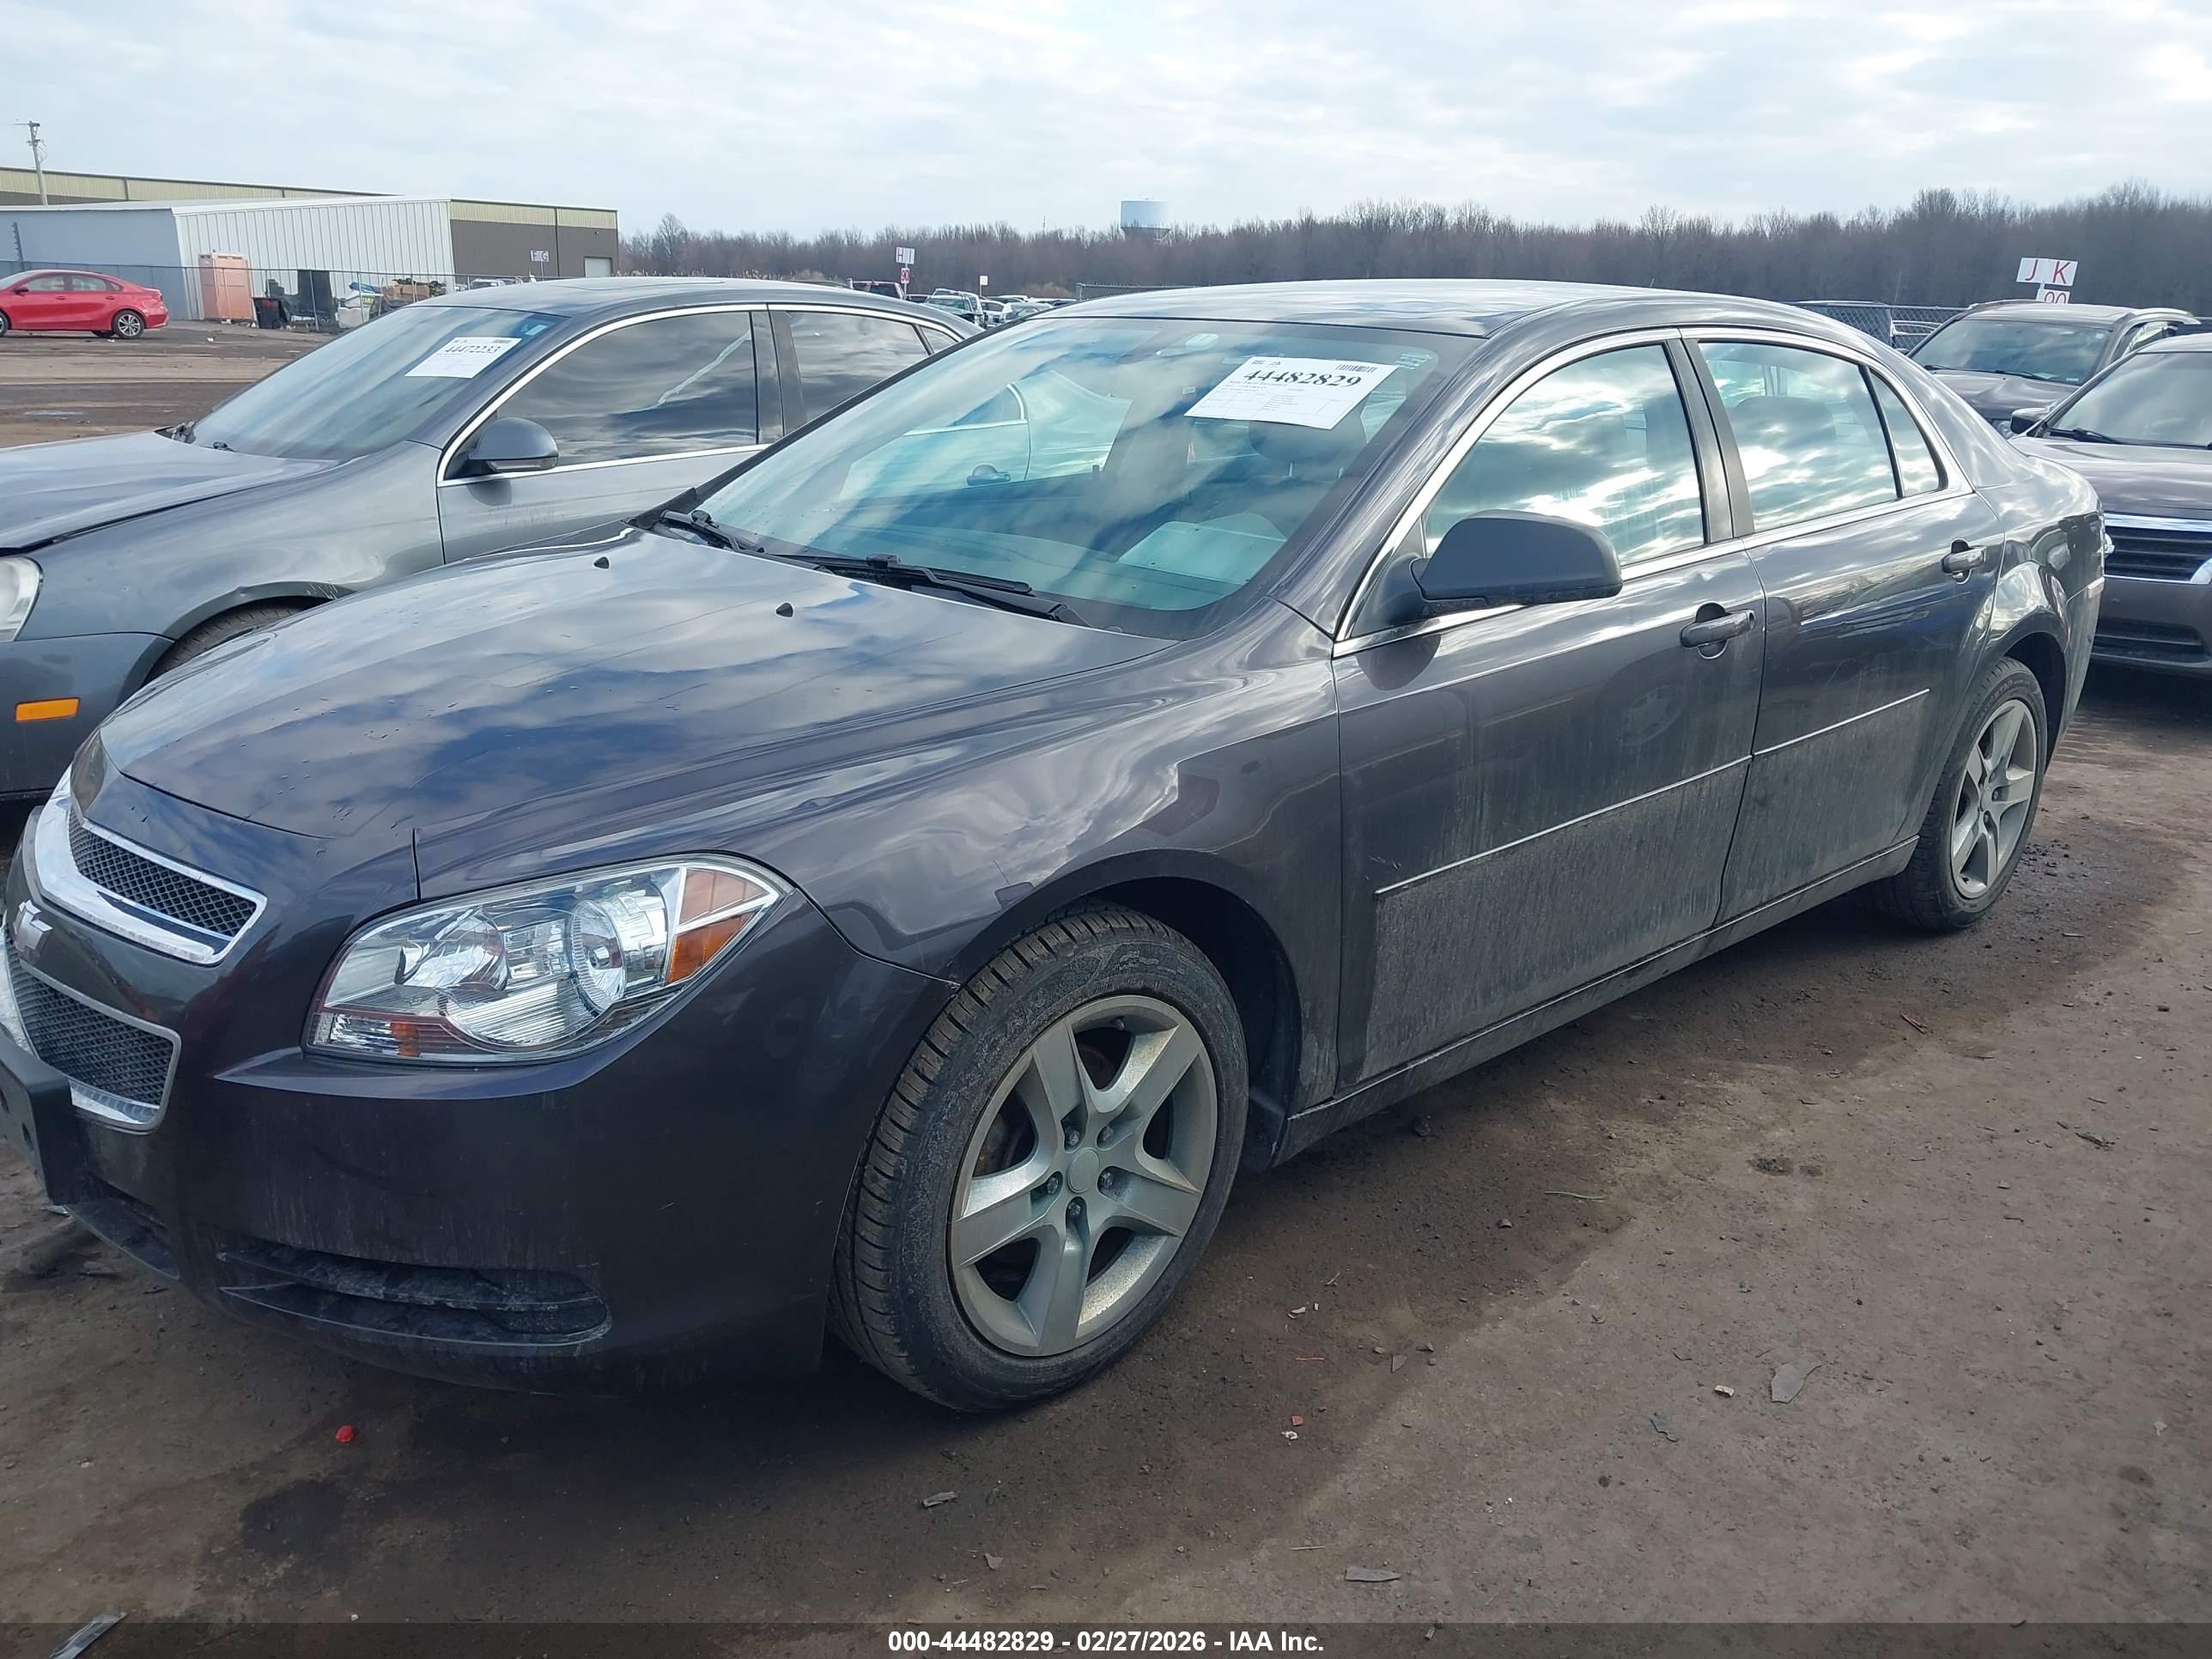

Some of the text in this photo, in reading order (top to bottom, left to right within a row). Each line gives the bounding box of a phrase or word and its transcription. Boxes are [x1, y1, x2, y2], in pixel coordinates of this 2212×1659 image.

[542, 251, 548, 261] G
[2025, 259, 2070, 284] J K
[1243, 369, 1362, 387] 44482829
